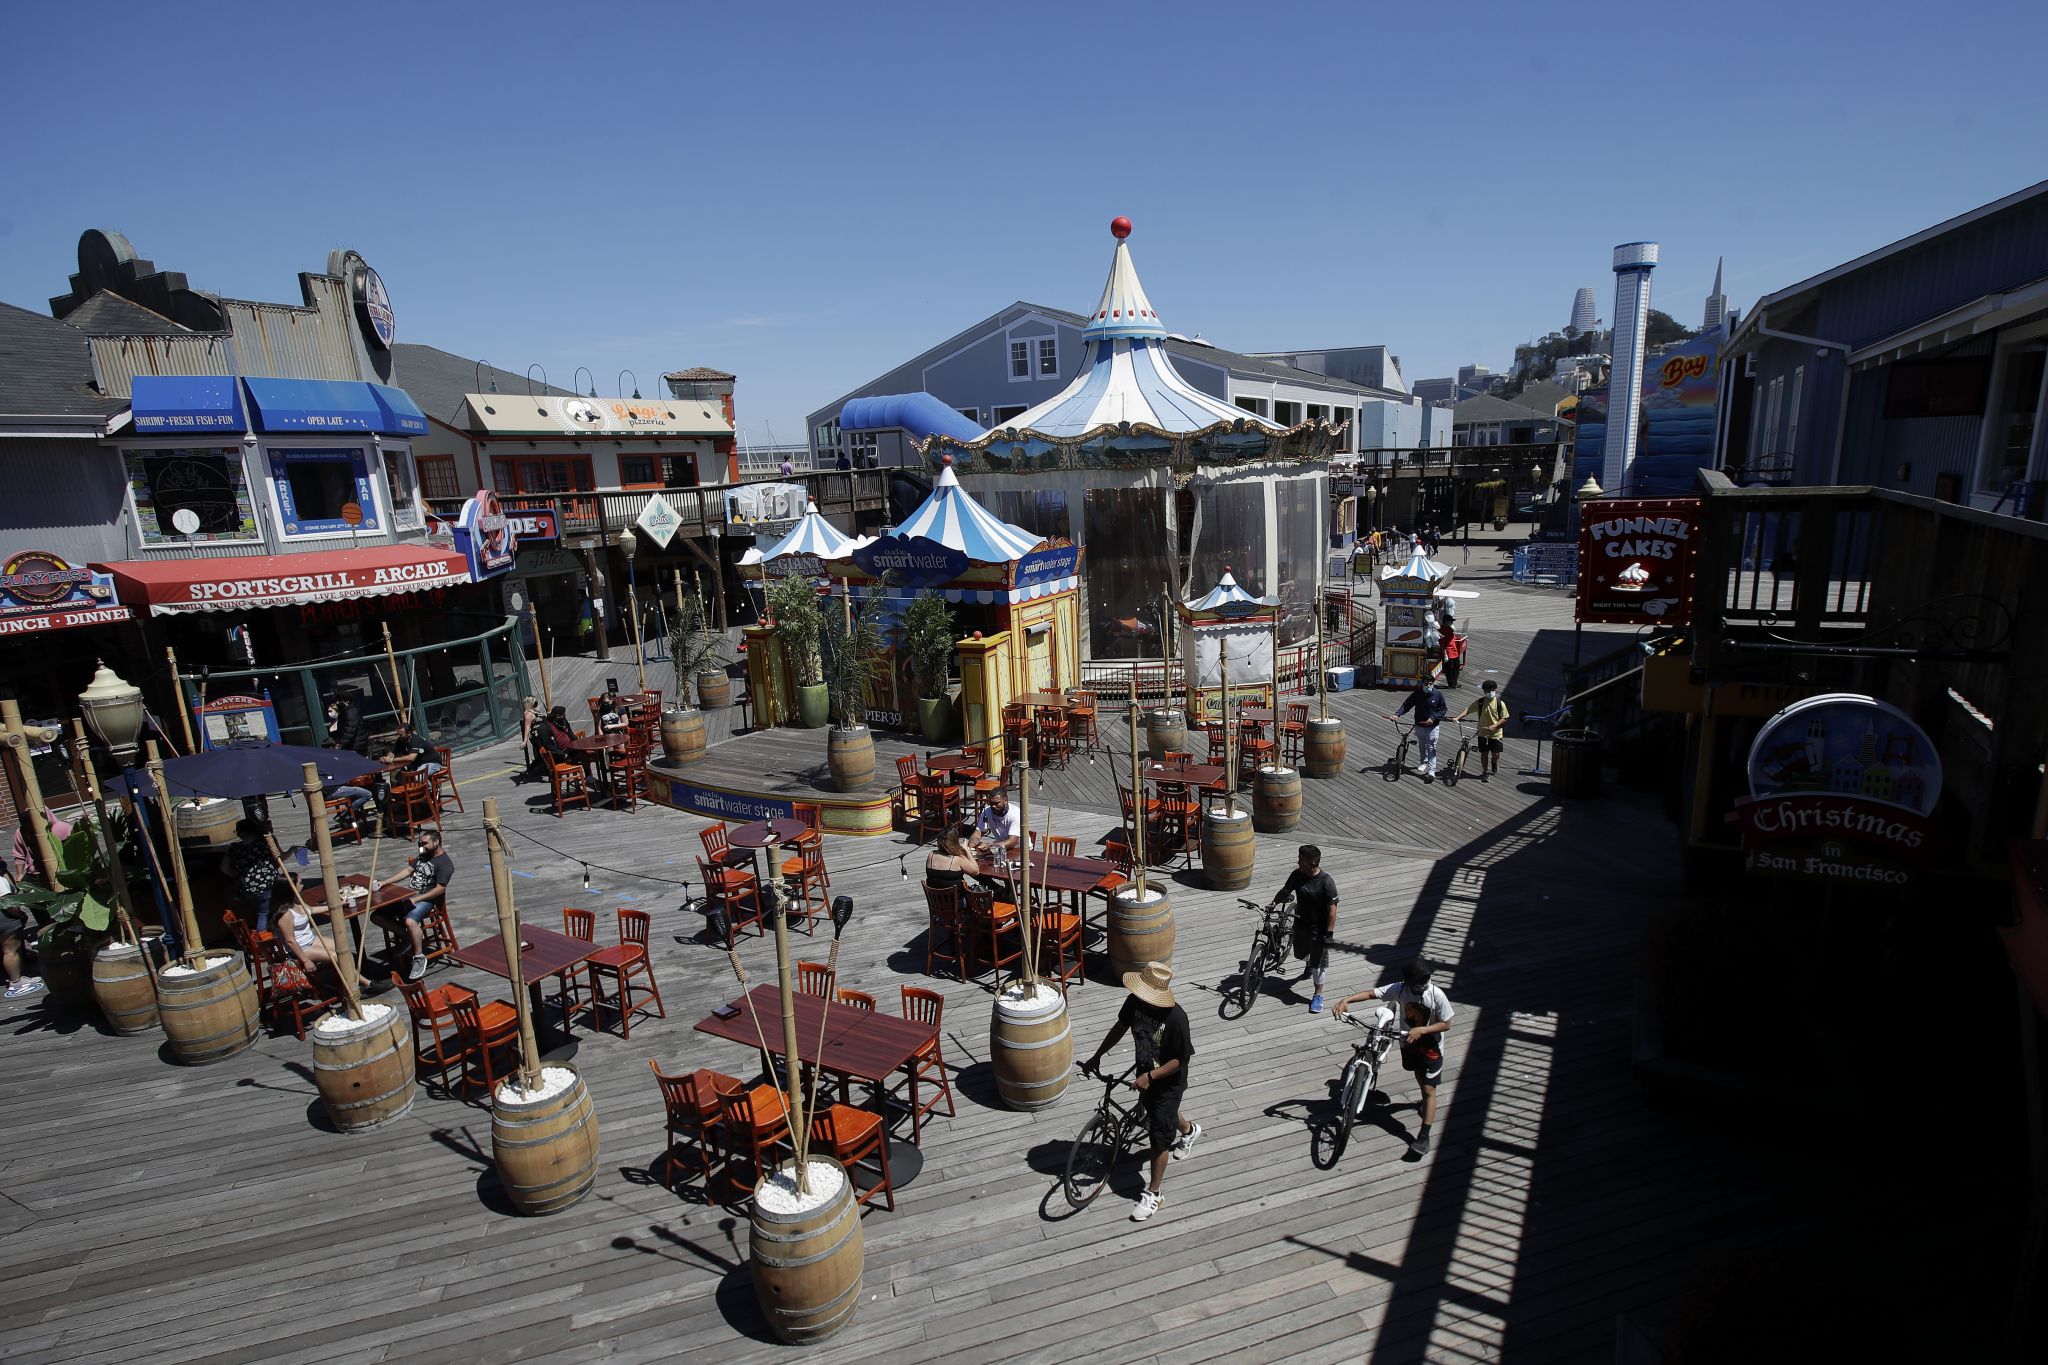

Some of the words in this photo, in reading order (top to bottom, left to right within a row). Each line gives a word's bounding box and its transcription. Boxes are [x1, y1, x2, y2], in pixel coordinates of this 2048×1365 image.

[1663, 355, 1708, 388] Bay
[134, 415, 166, 427] SHRIMP
[169, 415, 195, 426] FRESH
[195, 415, 214, 425] FISH
[217, 415, 234, 425] FUN
[307, 416, 325, 426] OPEN
[327, 416, 344, 426] LATE
[628, 418, 666, 428] pizzeria
[274, 468, 291, 516] MARKET
[358, 478, 369, 501] BAR
[437, 516, 539, 536] ADE
[1589, 516, 1690, 541] FUNNEL
[1605, 539, 1678, 560] CAKES
[778, 557, 819, 570] GIANT
[873, 552, 947, 569] smartwater
[1024, 559, 1057, 574] smartwater
[1057, 556, 1072, 568] stage
[0, 569, 79, 587] PLAYERS
[189, 572, 355, 600] SPORTSGRILL
[373, 560, 449, 584] ARCADE
[384, 580, 436, 593] WATERFRONT
[314, 592, 338, 601] LIVE
[339, 588, 371, 599] SPORTS
[3, 606, 26, 614] MEET
[51, 600, 88, 609] COMPETE
[169, 603, 205, 612] FAMILY
[210, 600, 245, 610] DINING
[260, 596, 297, 605] GAMES
[0, 616, 52, 633] UNCH
[64, 608, 137, 626] DINNER
[211, 697, 253, 708] PLAYERS
[694, 794, 752, 815] smartwater
[754, 803, 785, 819] stage
[1753, 800, 1925, 848] Christmas
[1823, 846, 1842, 858] in
[1757, 851, 1798, 872] San
[1802, 857, 1909, 885] Francisco
